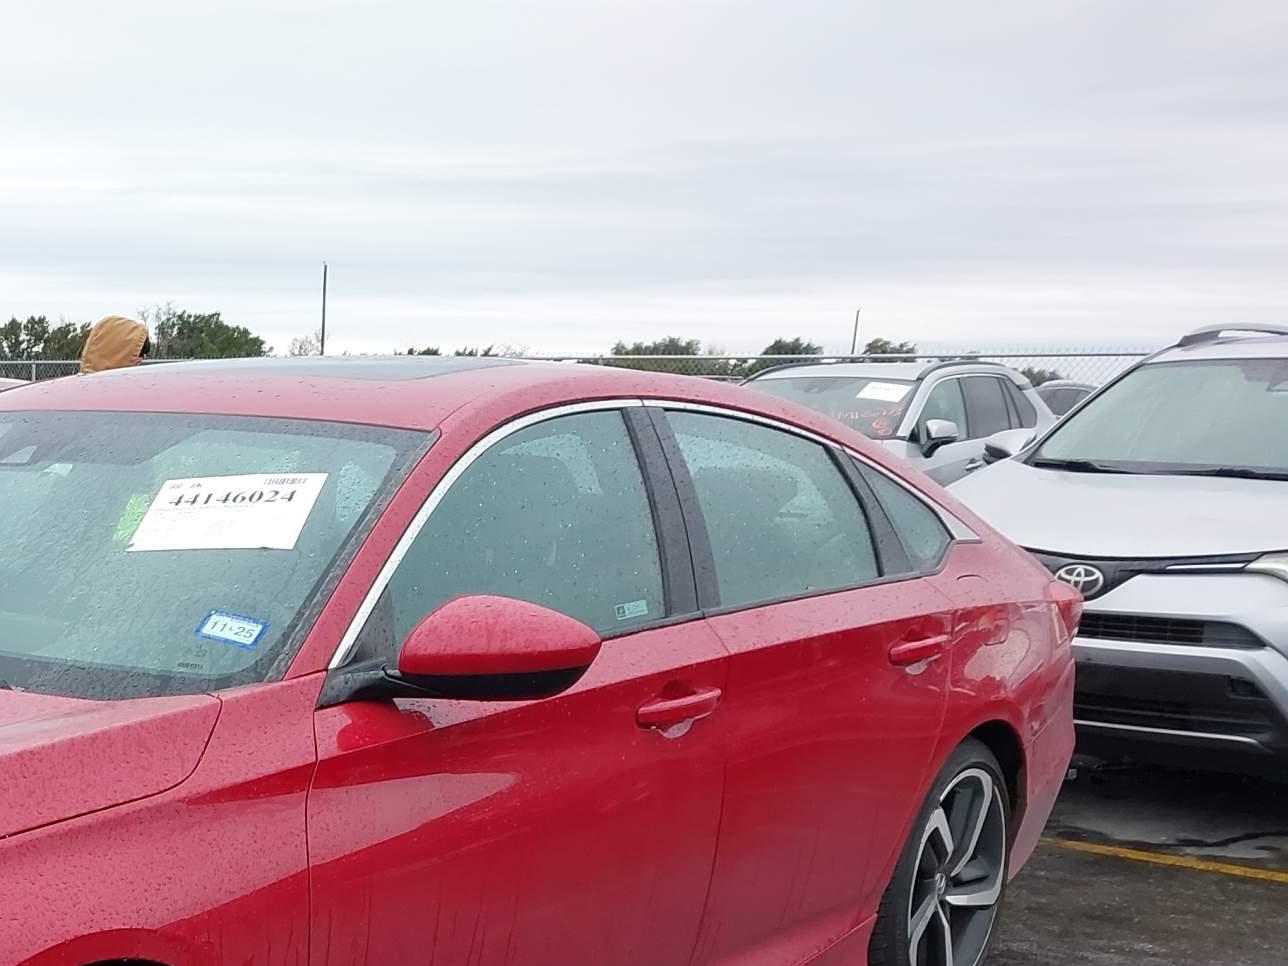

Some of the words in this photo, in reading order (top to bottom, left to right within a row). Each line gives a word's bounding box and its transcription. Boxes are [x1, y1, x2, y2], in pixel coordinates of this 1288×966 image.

[168, 489, 297, 507] 44146024
[211, 621, 228, 632] 11
[234, 626, 256, 639] 25
